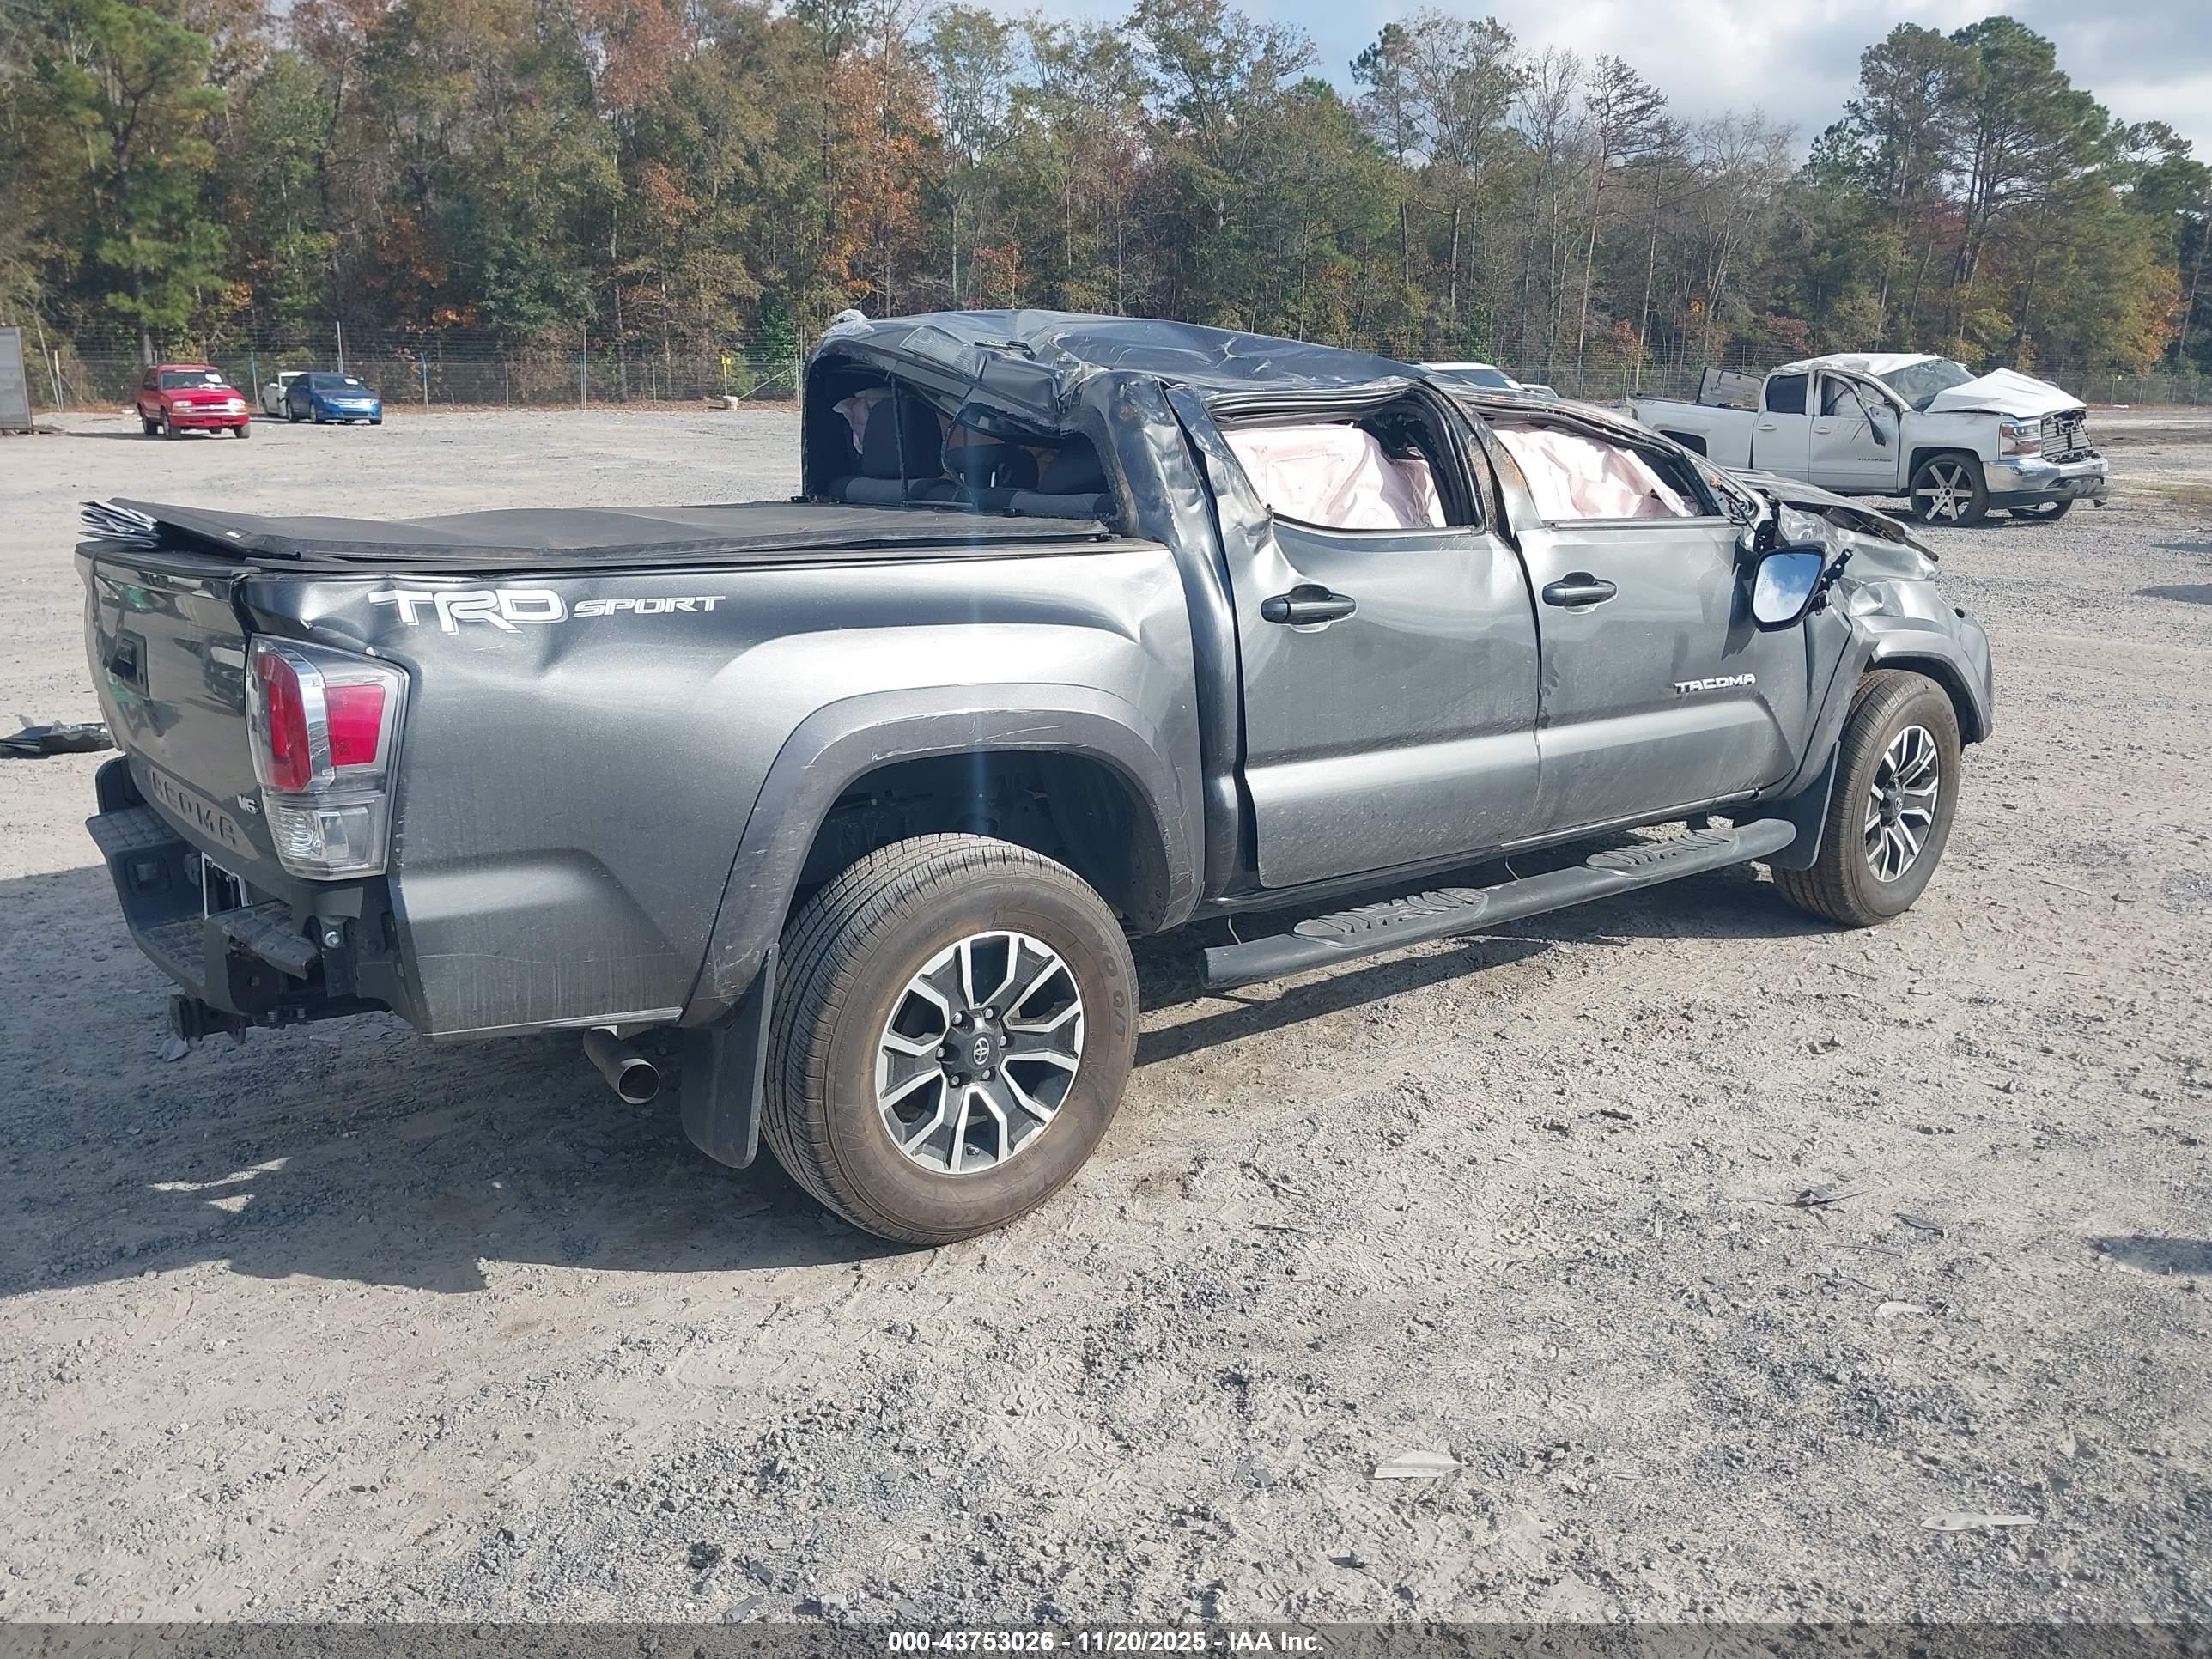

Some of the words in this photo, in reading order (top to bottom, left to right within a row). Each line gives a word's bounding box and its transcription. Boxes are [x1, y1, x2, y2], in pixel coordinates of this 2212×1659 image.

[367, 588, 568, 635] TRD
[573, 595, 726, 618] SPORT
[1674, 673, 1757, 694] TACOMA
[236, 793, 261, 816] V6
